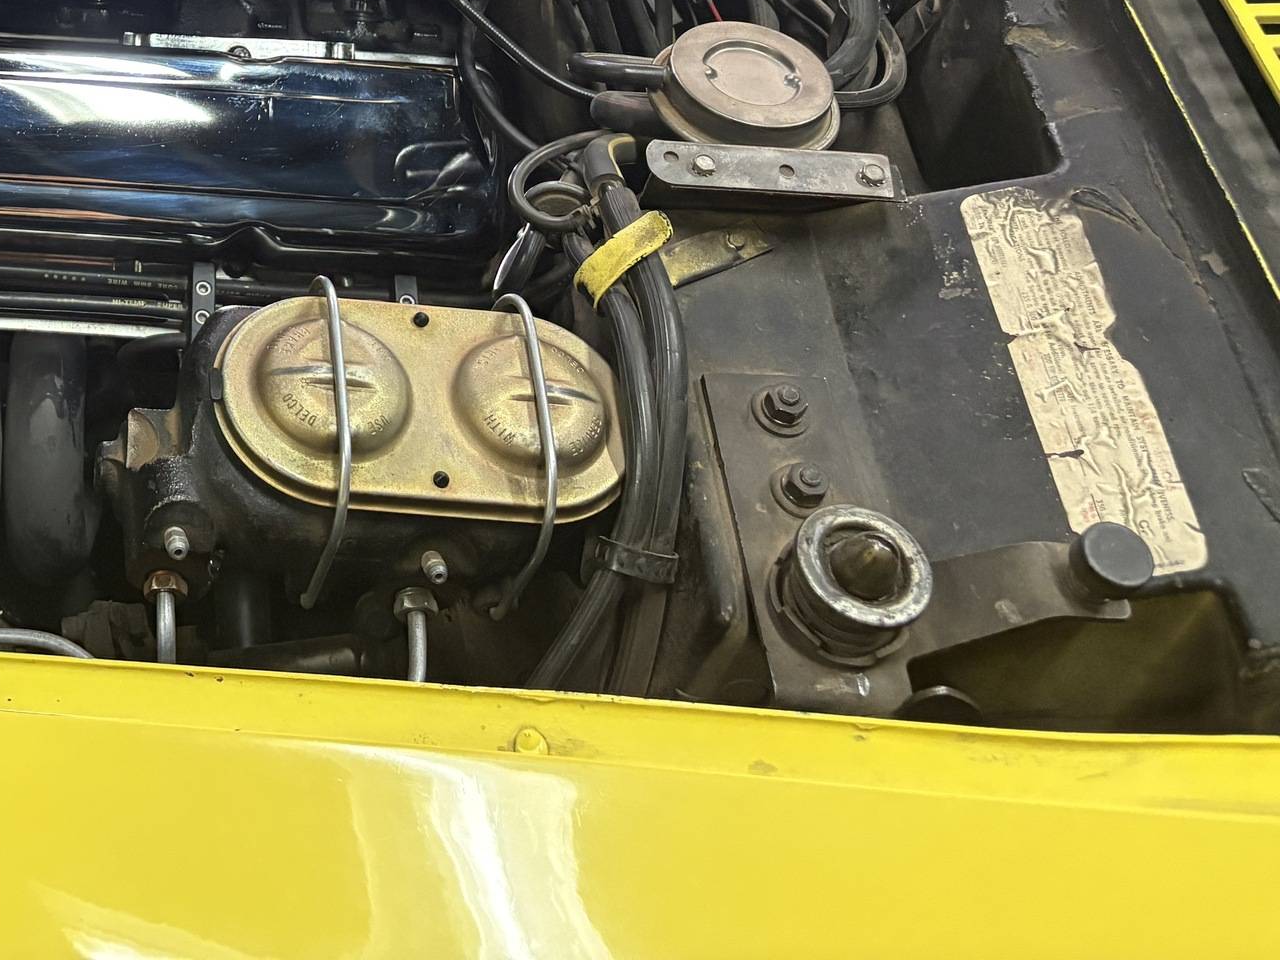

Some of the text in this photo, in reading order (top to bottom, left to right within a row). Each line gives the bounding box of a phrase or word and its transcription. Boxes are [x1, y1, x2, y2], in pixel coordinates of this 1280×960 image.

[107, 277, 128, 287] WIRE
[282, 392, 391, 436] USE DELCO
[1116, 378, 1125, 390] TO
[1122, 394, 1141, 432] MAINTAIN
[483, 410, 517, 448] WITH
